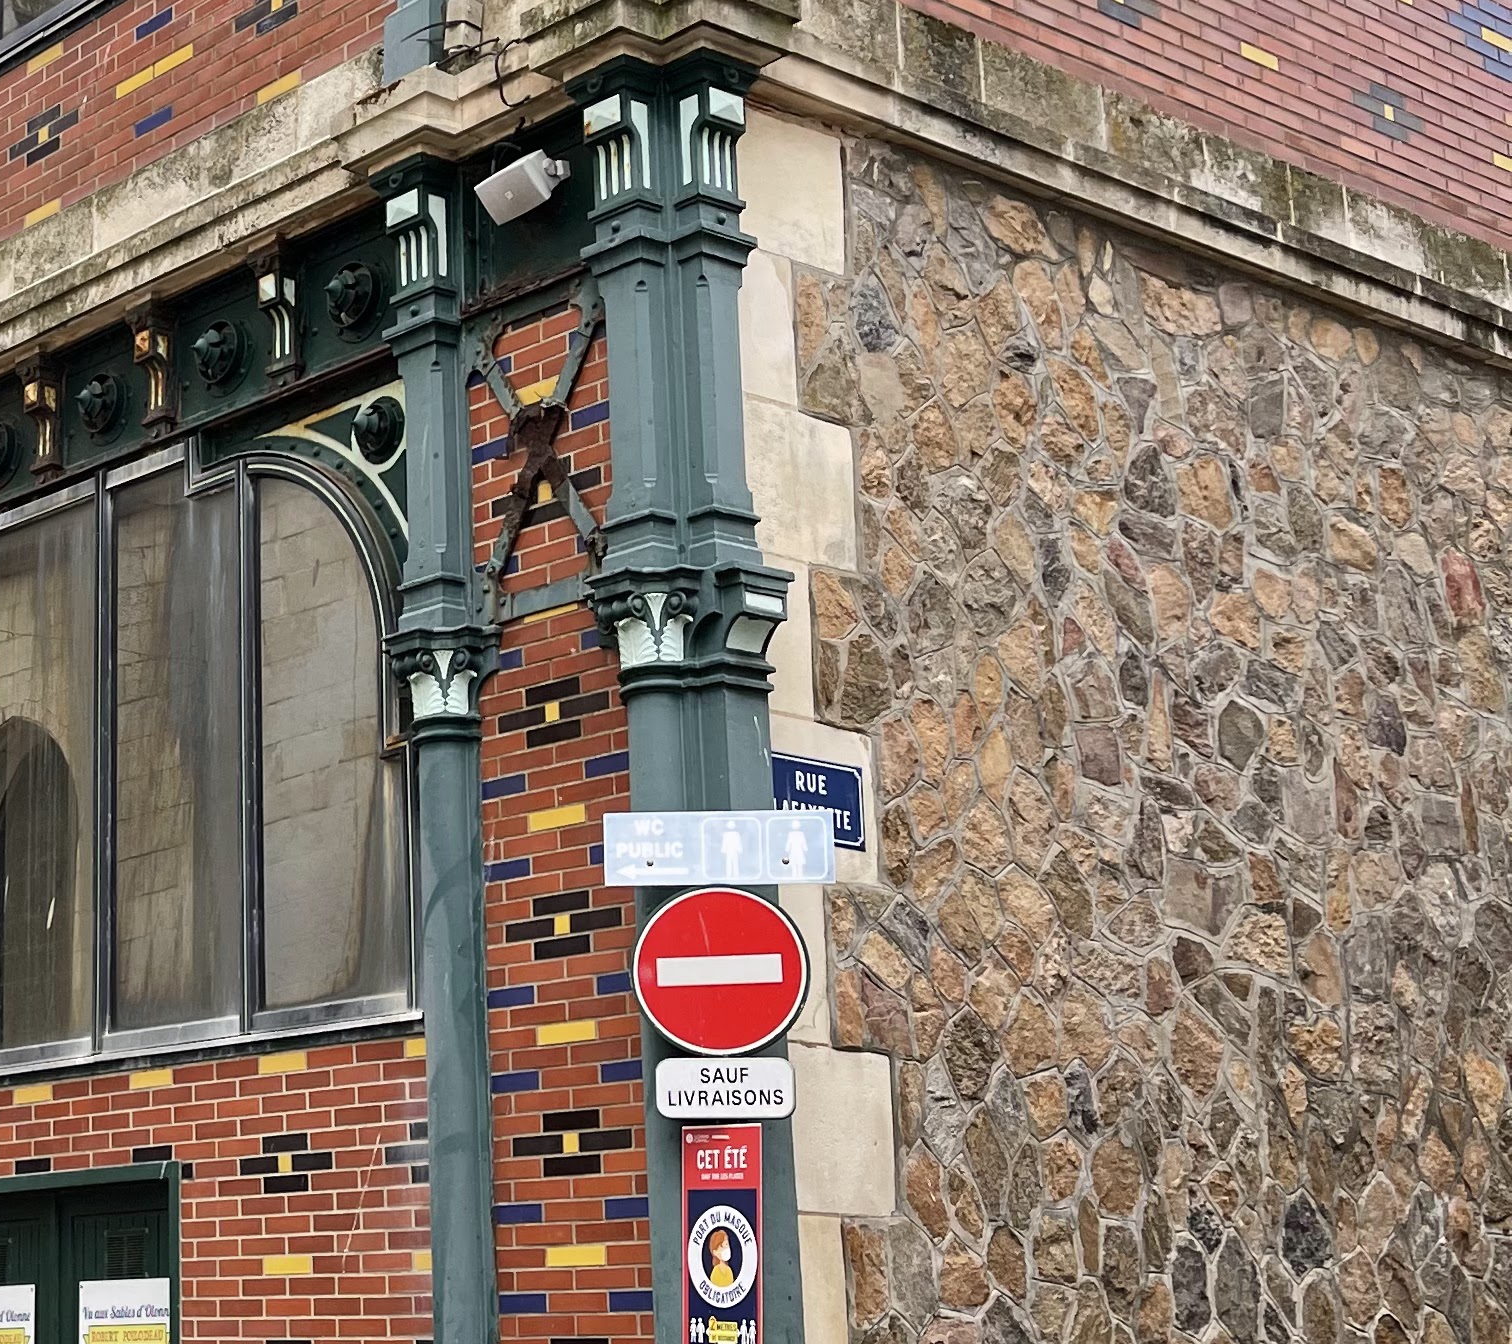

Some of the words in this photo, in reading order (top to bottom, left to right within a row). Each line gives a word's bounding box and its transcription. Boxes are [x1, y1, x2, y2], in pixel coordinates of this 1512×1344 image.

[795, 770, 827, 795] RUE
[634, 819, 664, 835] WC
[616, 842, 683, 858] PUBLIC
[700, 1067, 749, 1084] SAUF
[668, 1089, 784, 1106] LIVRAISONS
[697, 1149, 720, 1169] CET
[724, 1145, 748, 1169] ÉTÉ
[693, 1218, 710, 1246] PORT
[710, 1211, 721, 1225] DU
[724, 1211, 753, 1246] MASQUE
[699, 1280, 746, 1304] OBLIGATOIRE
[83, 1306, 93, 1319] Vu
[95, 1309, 108, 1319] aux
[110, 1305, 135, 1319] Sables
[92, 1331, 119, 1343] ROBERT
